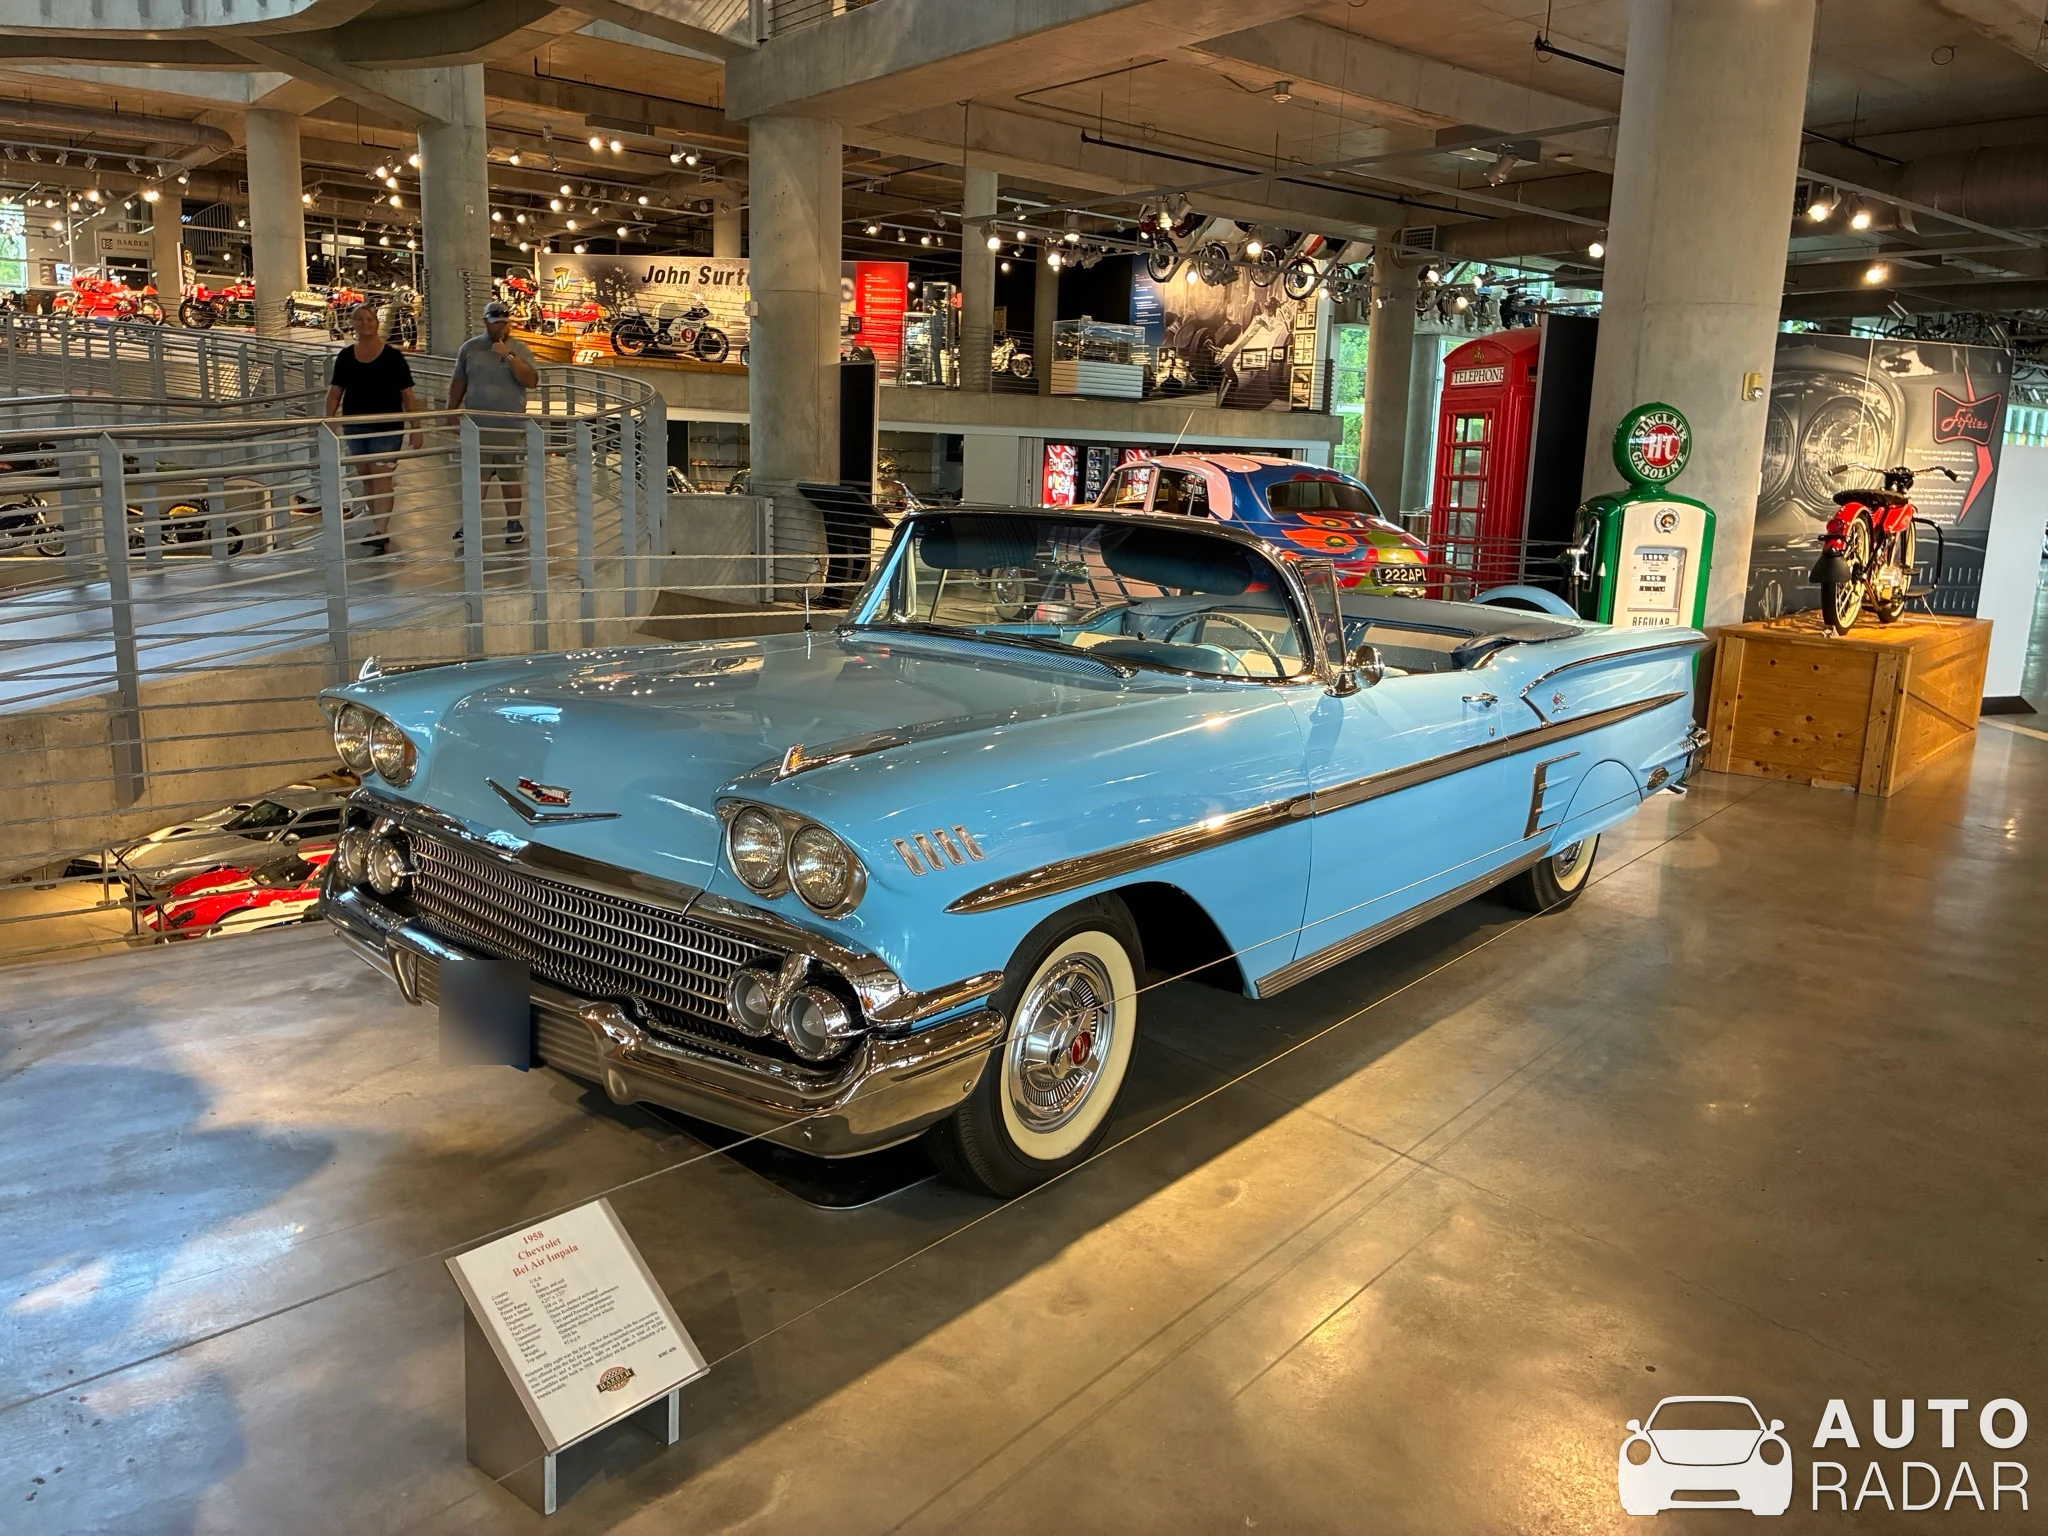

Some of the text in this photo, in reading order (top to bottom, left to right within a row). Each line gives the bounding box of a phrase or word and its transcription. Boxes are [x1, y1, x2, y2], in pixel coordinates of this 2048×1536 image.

[116, 238, 150, 248] BARBER
[641, 265, 750, 287] John Surt
[403, 293, 415, 304] 42
[685, 329, 693, 342] 9
[1453, 368, 1504, 384] TELEPHONE
[1634, 413, 1688, 443] SINCLAIR
[1631, 452, 1687, 479] GASOLINE
[1632, 616, 1670, 627] REGULAR
[521, 1229, 545, 1245] 1958
[516, 1236, 562, 1261] Chevrolet
[511, 1242, 580, 1277] Bel Air Impala
